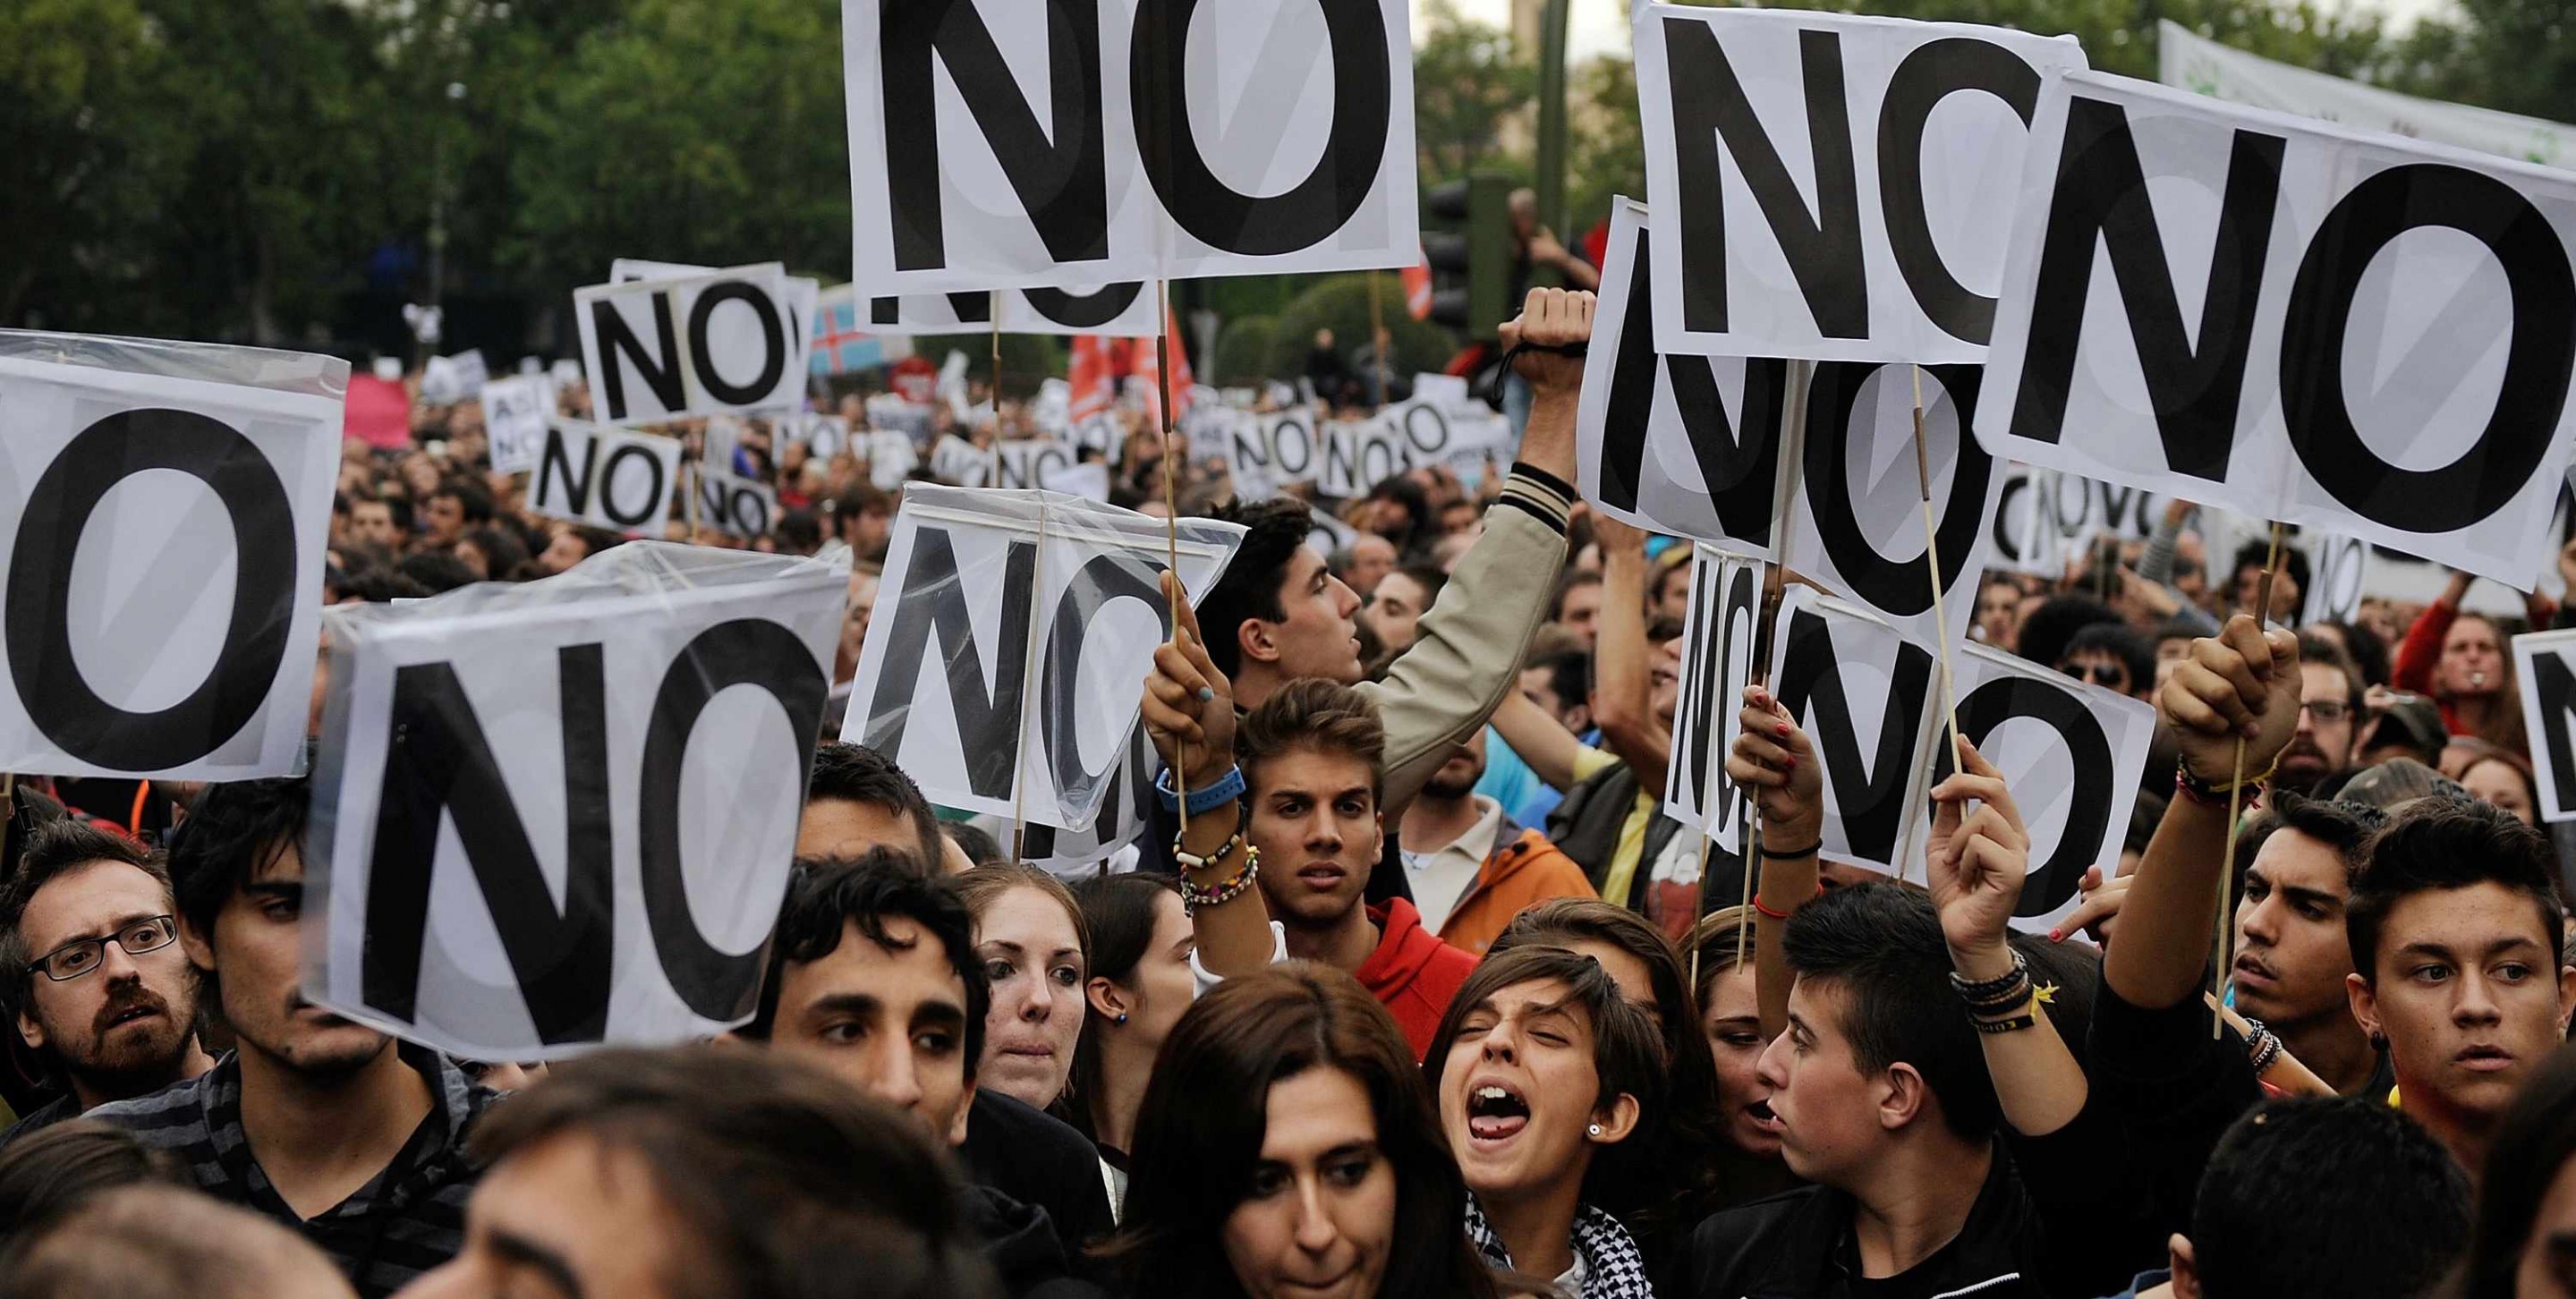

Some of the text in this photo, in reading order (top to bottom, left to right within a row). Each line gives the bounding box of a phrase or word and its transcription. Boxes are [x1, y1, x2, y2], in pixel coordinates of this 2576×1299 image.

[879, 0, 1391, 271] NO
[591, 281, 786, 420] NO
[1233, 420, 1311, 473] NO
[1599, 225, 1994, 617] NO
[2009, 96, 2576, 535] NO
[537, 428, 664, 526] NO
[697, 479, 767, 538] NO
[1327, 430, 1393, 490] NO
[862, 524, 1188, 802] NO
[1671, 560, 1754, 834] NO
[1763, 605, 2114, 918] NO
[361, 617, 829, 1044] NO
